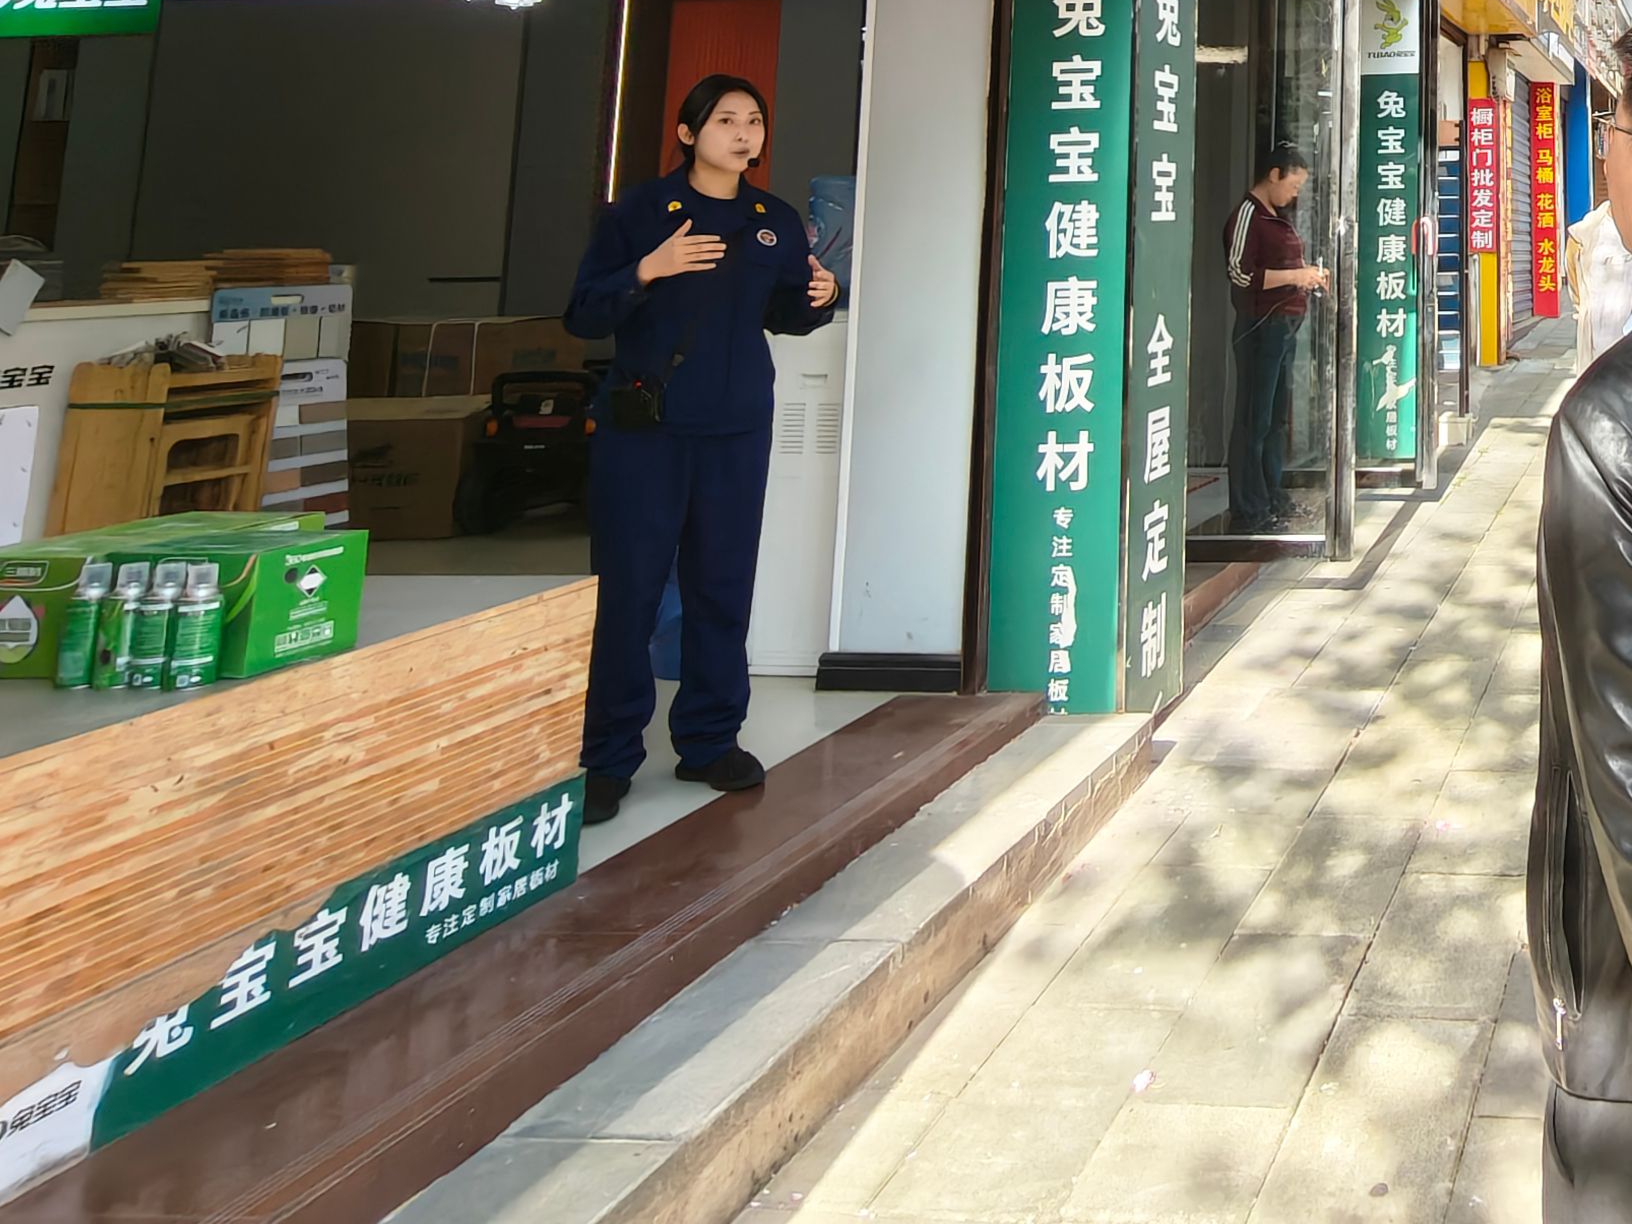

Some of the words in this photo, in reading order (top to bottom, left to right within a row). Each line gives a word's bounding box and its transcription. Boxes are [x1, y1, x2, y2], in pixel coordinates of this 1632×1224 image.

[1535, 87, 1555, 140] 浴室柜
[1470, 107, 1495, 250] 橱柜门批发定制
[1536, 148, 1555, 185] 马桶
[1375, 89, 1408, 339] 兔宝宝健康板材
[1537, 238, 1557, 293] 水龙头
[1140, 313, 1175, 678] 全屋定制
[424, 858, 560, 945] 专注定制家居板材
